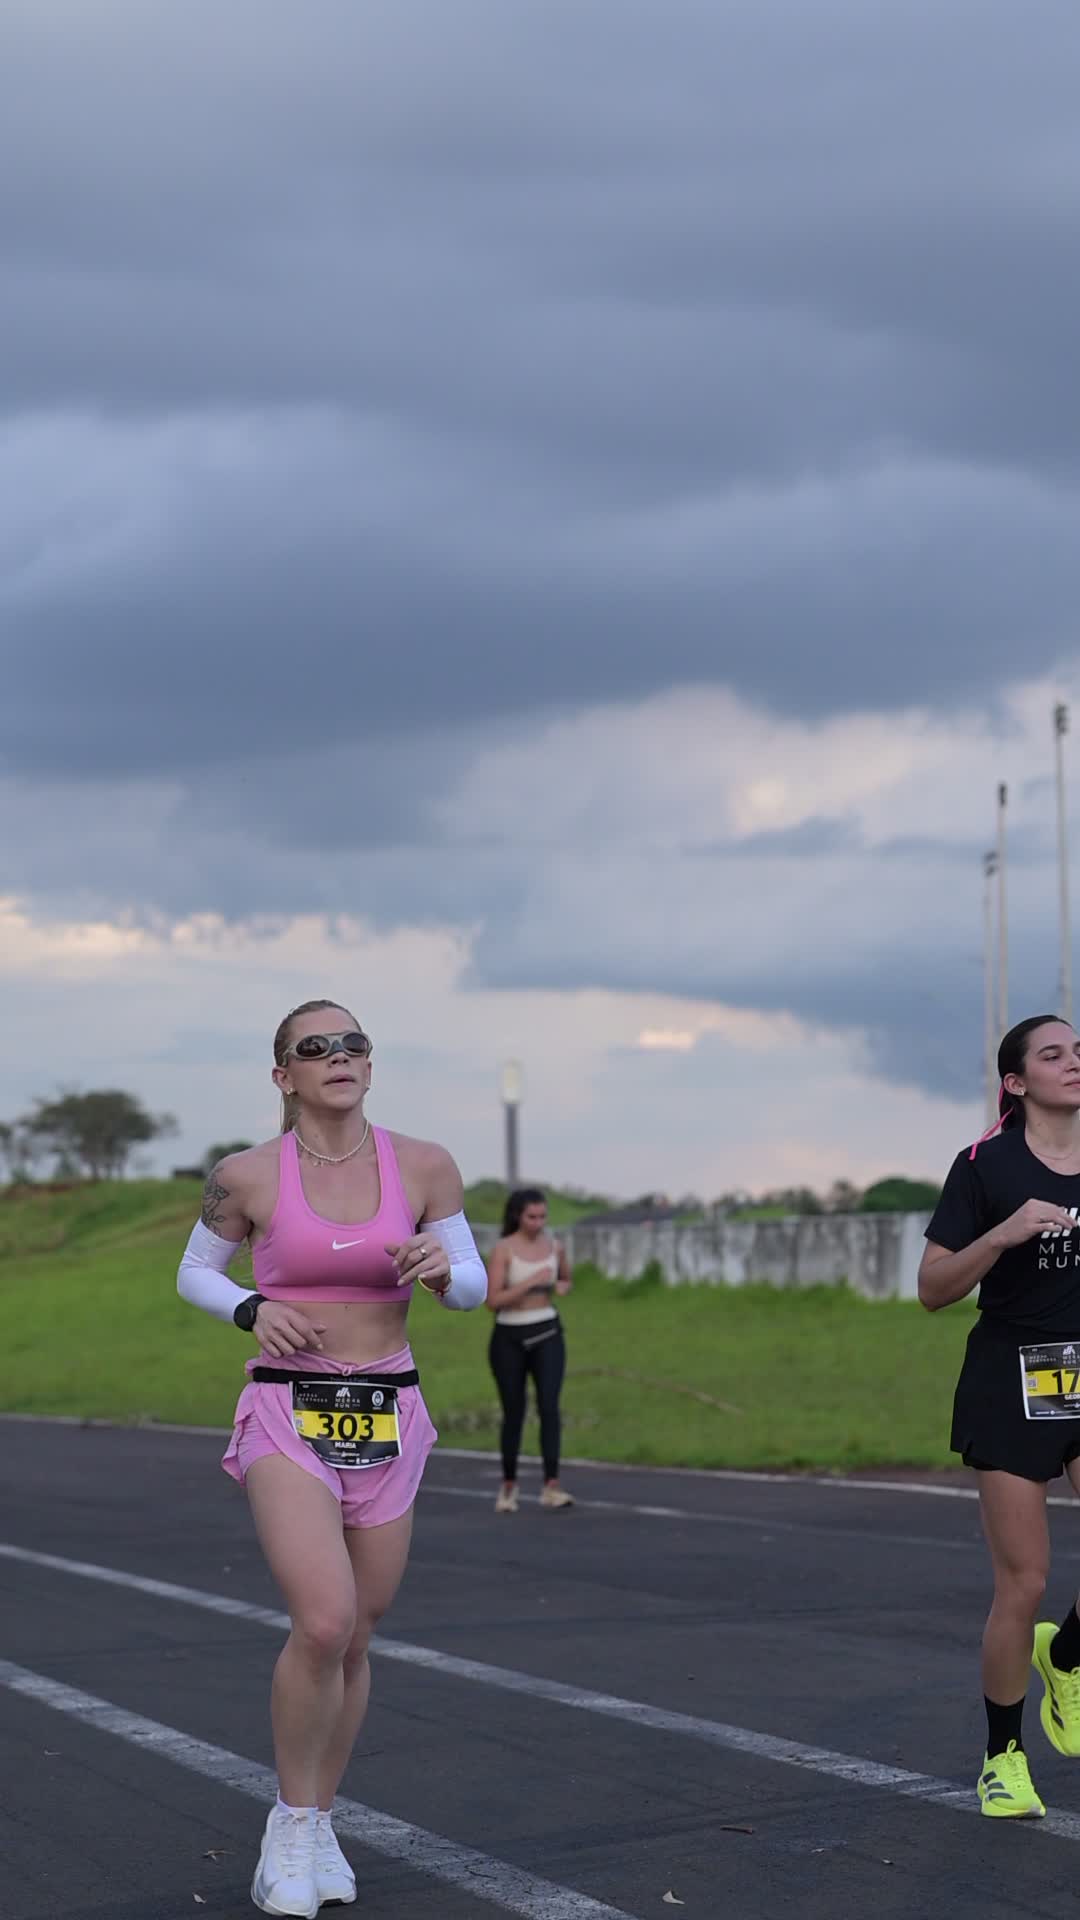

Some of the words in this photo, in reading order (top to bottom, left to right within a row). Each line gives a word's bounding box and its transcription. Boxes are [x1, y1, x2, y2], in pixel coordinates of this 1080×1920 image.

[1038, 1240, 1080, 1255] ME
[317, 1413, 374, 1441] 303
[334, 1441, 357, 1449] MARIA
